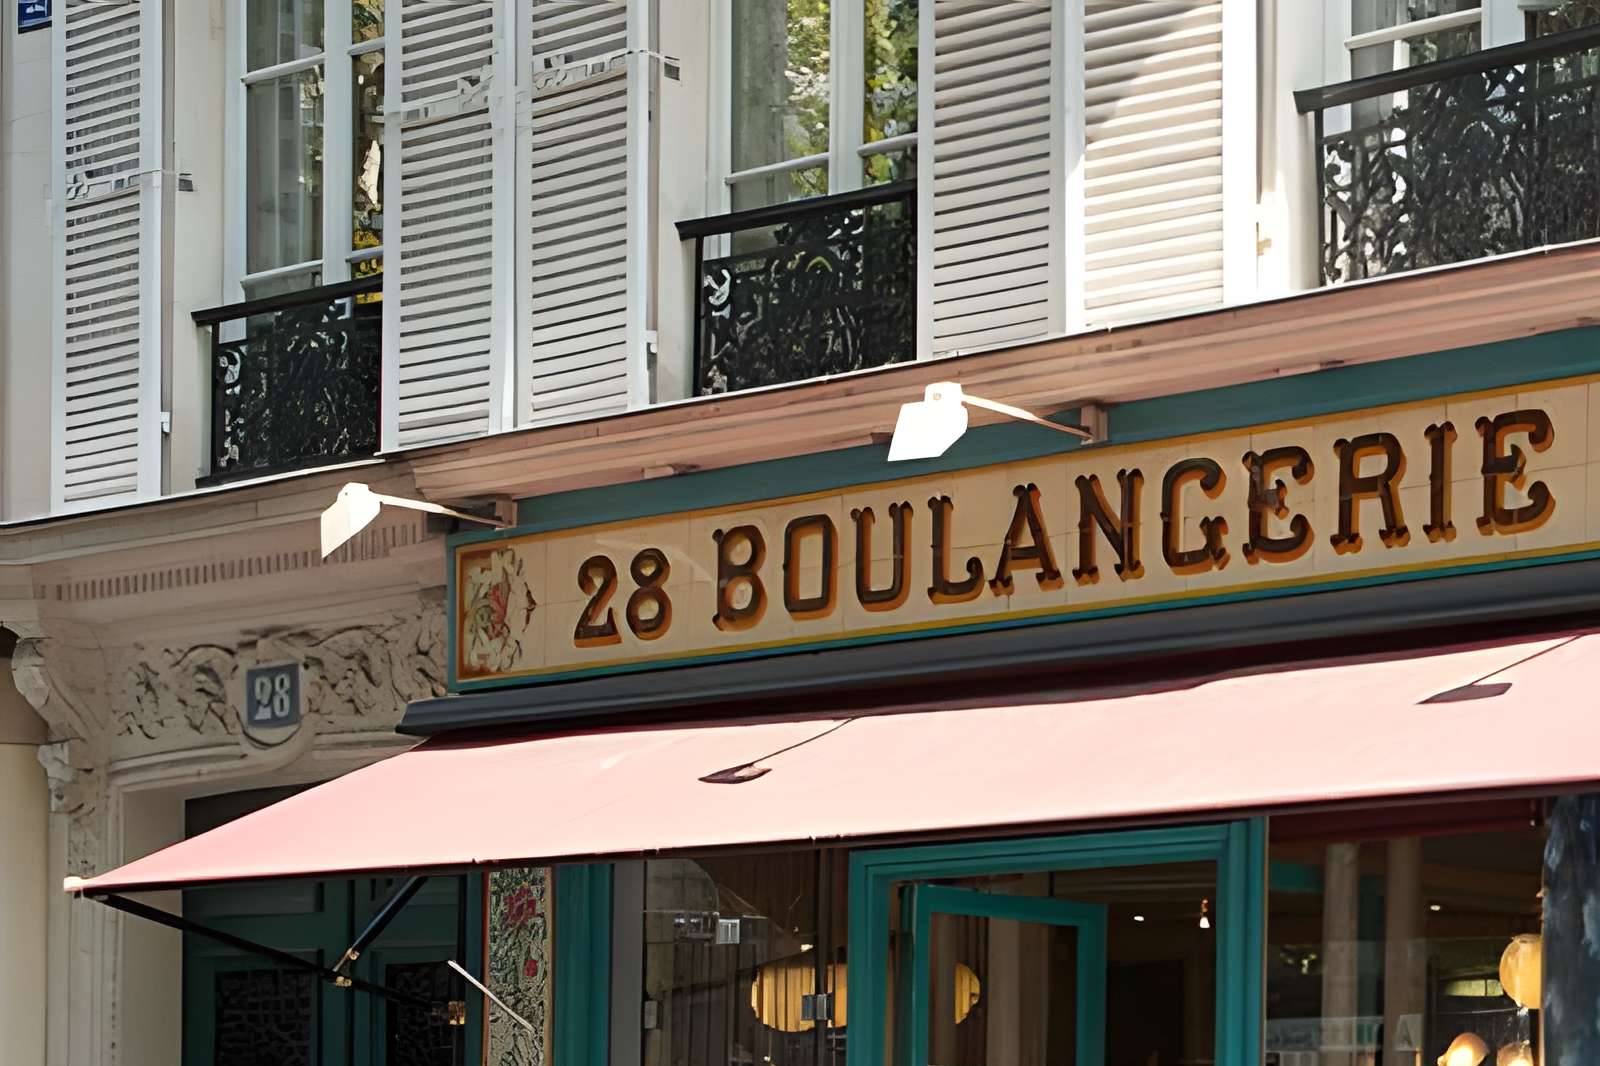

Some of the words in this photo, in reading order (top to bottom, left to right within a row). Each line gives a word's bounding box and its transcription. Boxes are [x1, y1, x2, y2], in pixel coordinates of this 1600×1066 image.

[573, 547, 672, 648] 28
[711, 407, 1556, 633] BOULANGERIE
[254, 673, 291, 720] 28
